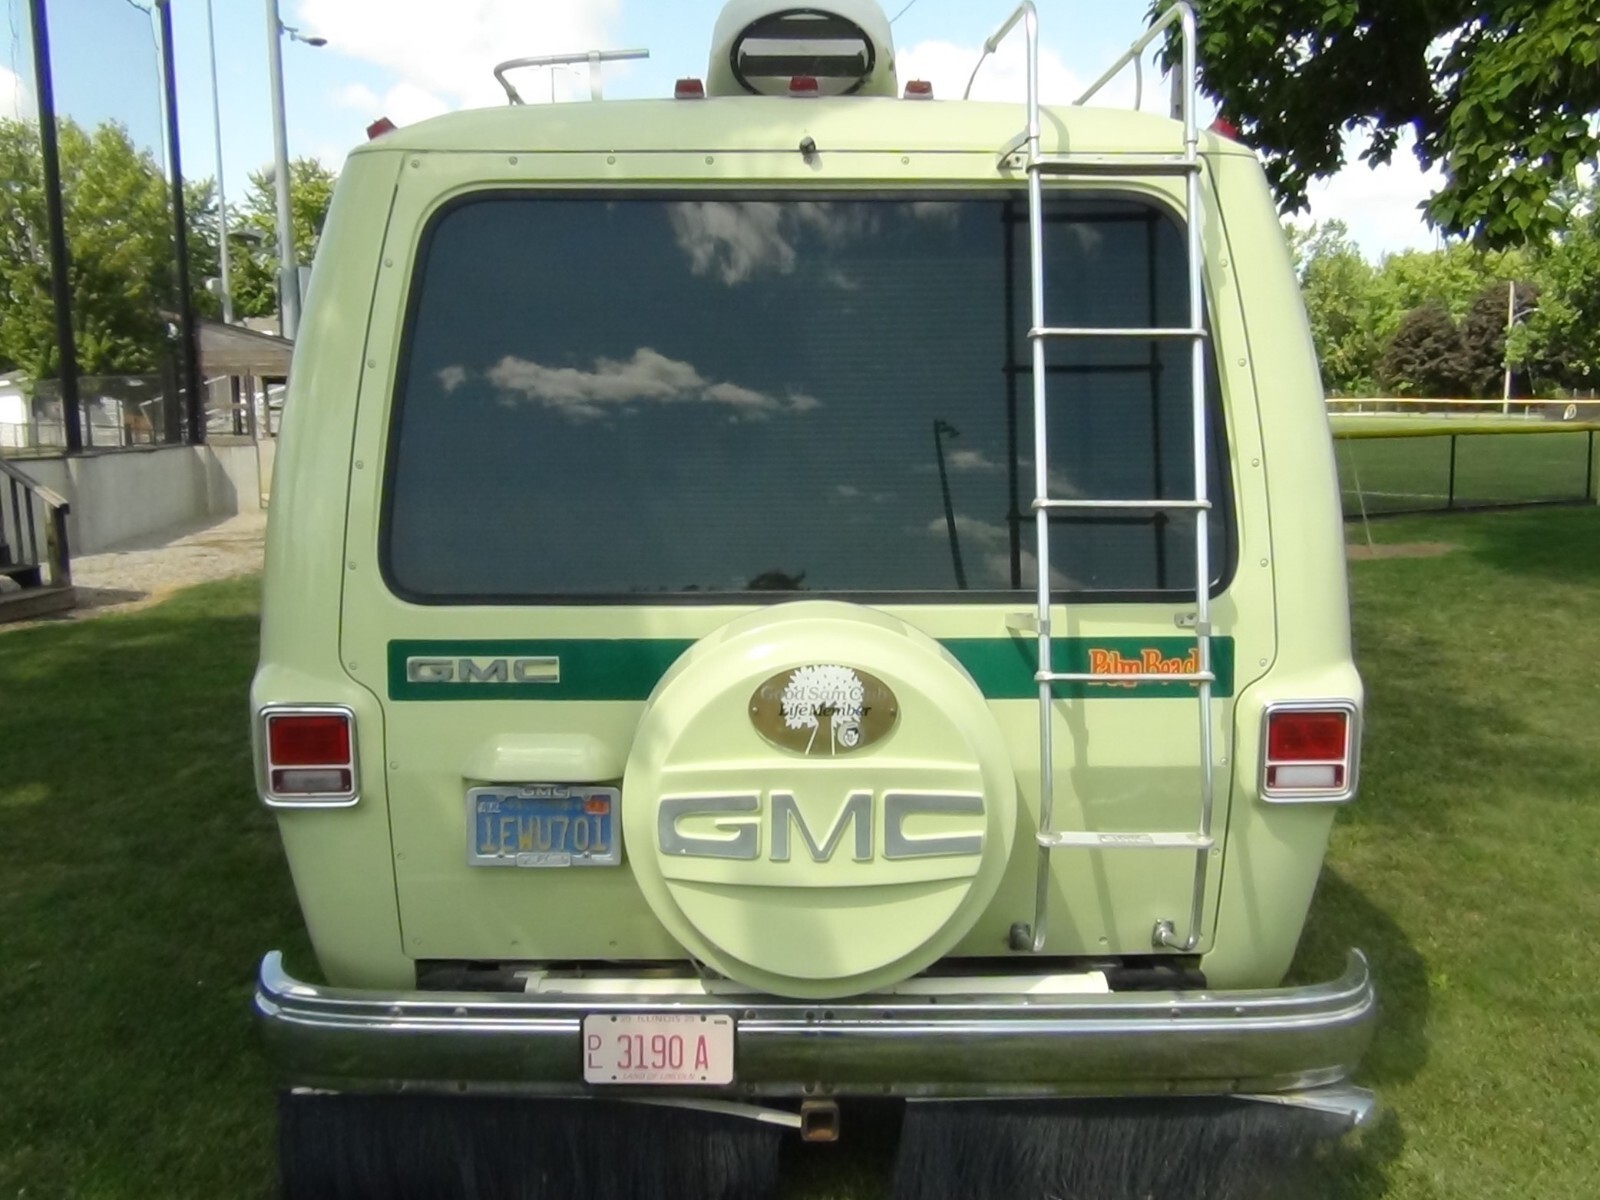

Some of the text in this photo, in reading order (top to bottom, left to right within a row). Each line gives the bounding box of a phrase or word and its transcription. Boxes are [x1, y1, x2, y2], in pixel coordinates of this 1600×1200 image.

[408, 657, 560, 683] GMC
[808, 686, 847, 701] Sam
[778, 701, 872, 718] Life Member
[657, 789, 987, 863] GMC
[617, 1034, 709, 1070] 3190 A
